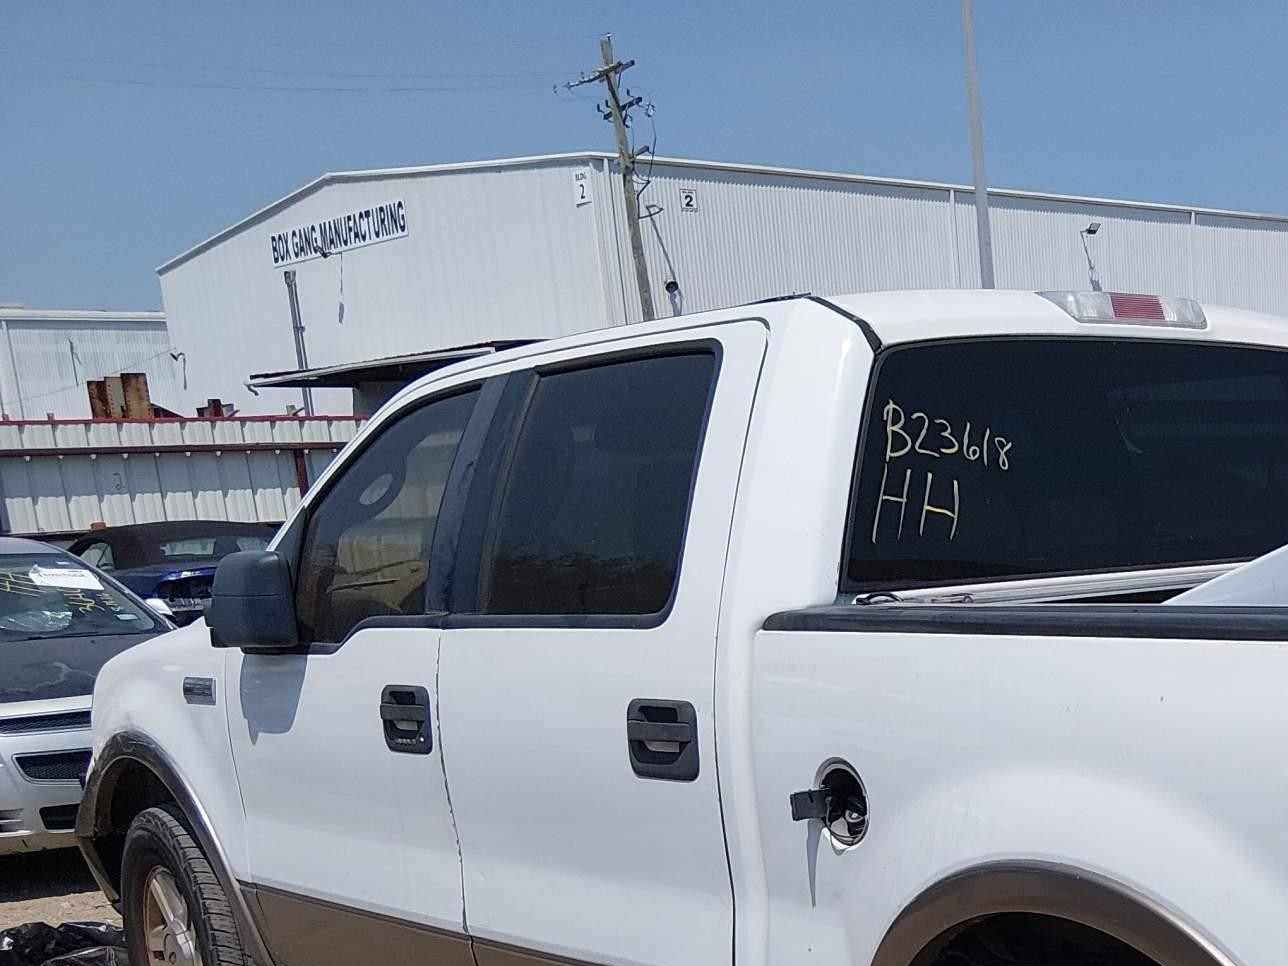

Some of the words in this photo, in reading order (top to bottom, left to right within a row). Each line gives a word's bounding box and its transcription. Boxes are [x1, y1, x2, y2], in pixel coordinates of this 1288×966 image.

[579, 183, 586, 199] 2
[684, 194, 694, 207] 2
[270, 233, 292, 264] BOX
[291, 224, 320, 259] GANG
[319, 200, 406, 252] MANUFACTURING
[883, 399, 1012, 471] B23618
[871, 463, 960, 544] HH
